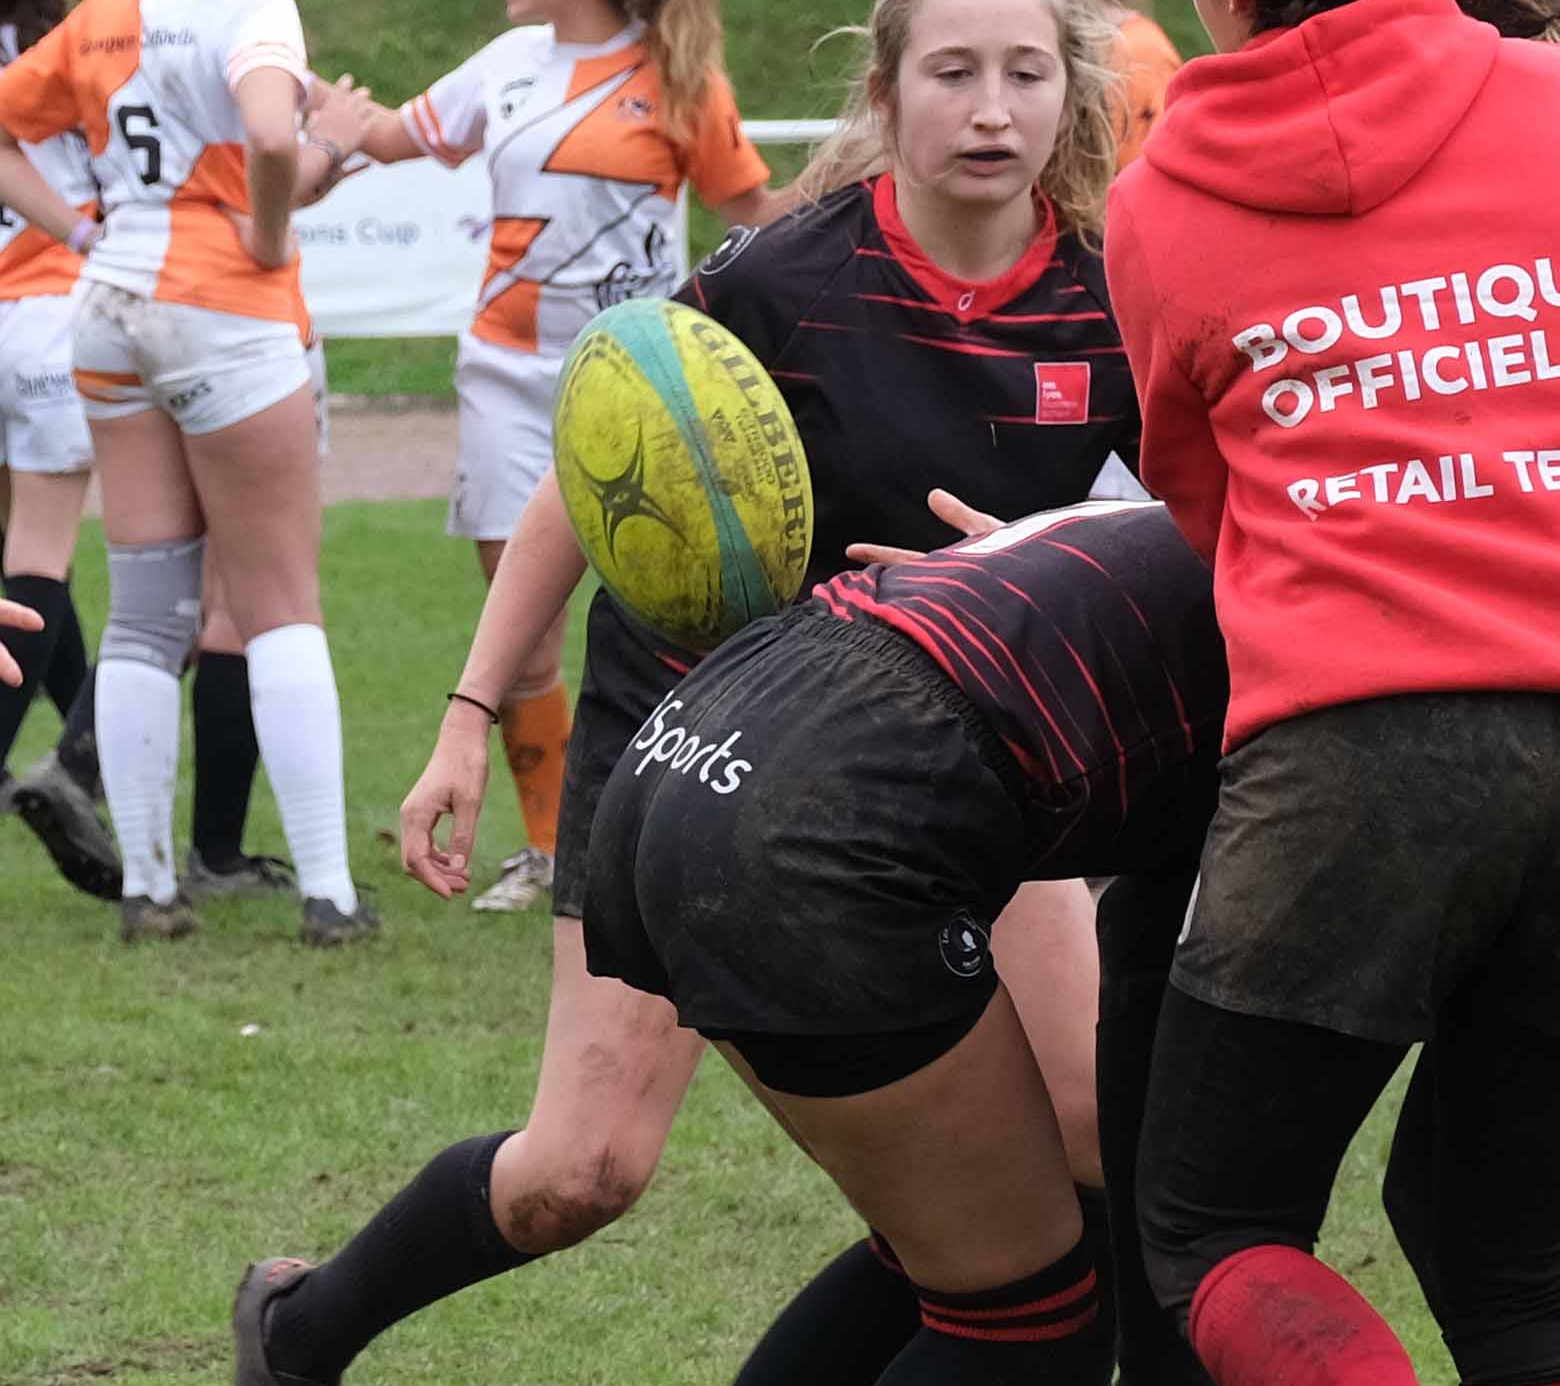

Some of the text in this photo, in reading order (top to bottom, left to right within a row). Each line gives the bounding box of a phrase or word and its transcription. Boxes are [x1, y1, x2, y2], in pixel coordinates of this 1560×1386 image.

[354, 216, 421, 247] Cup
[688, 321, 809, 571] GILBERT
[1286, 451, 1495, 522] RETAIL
[635, 697, 754, 795] Sports
